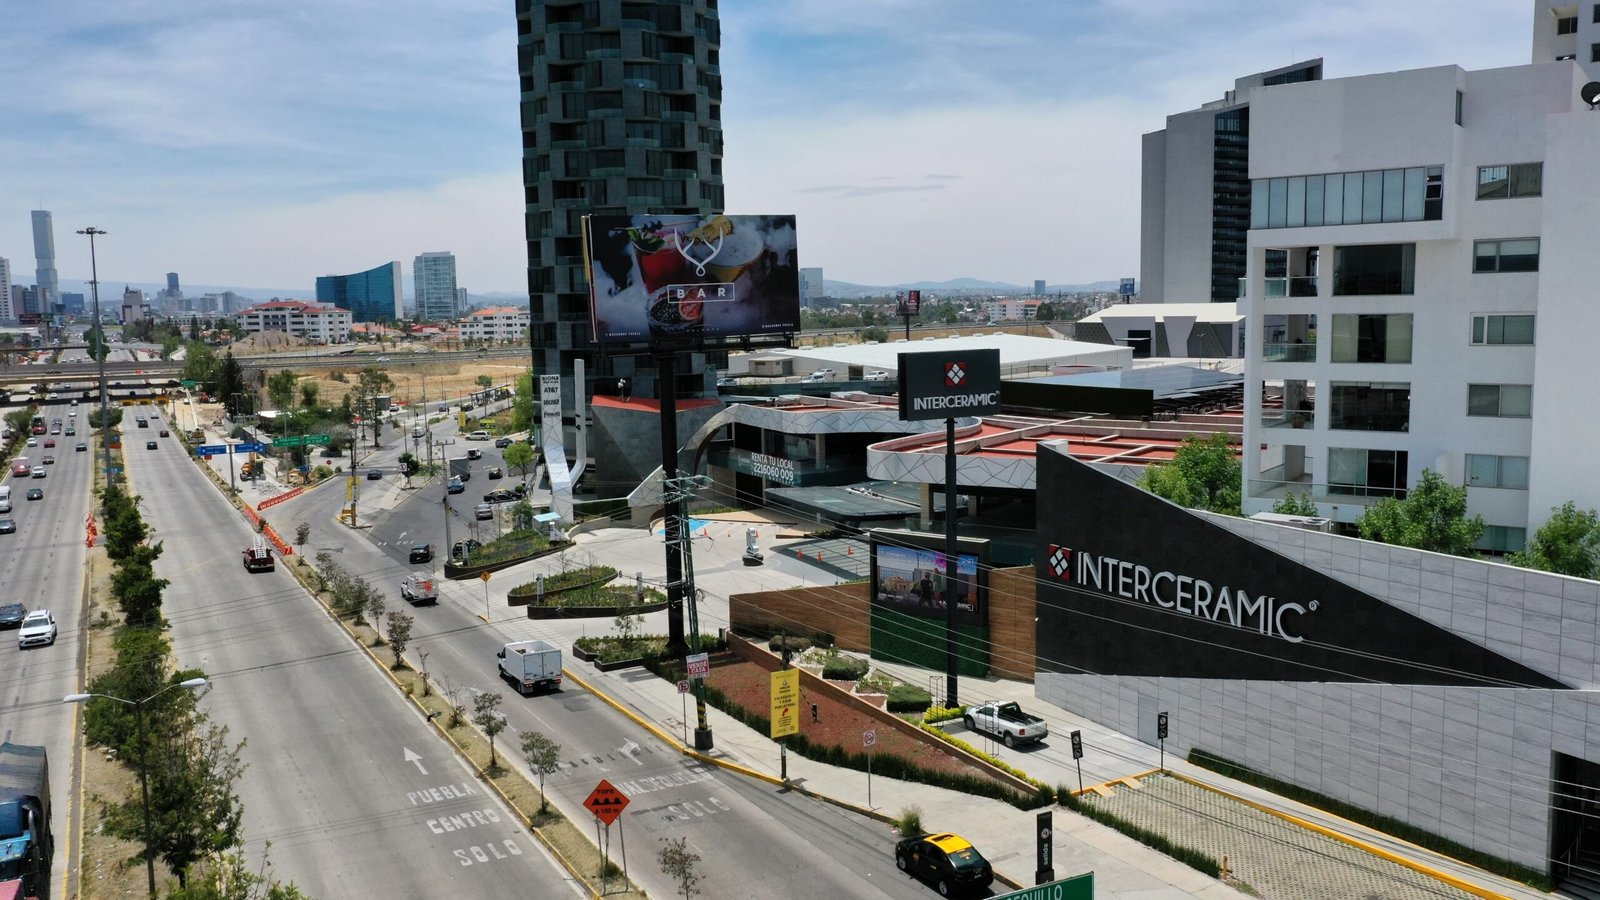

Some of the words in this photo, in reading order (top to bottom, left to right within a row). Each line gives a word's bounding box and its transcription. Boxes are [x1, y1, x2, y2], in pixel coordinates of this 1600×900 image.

[752, 452, 768, 464] RENTA
[769, 456, 777, 466] TU
[777, 457, 794, 470] LOCAL
[780, 468, 794, 481] 009
[688, 661, 707, 669] VENDE
[406, 782, 478, 805] PUEBLA
[426, 808, 502, 834] CENTRO
[452, 839, 522, 866] SOLO
